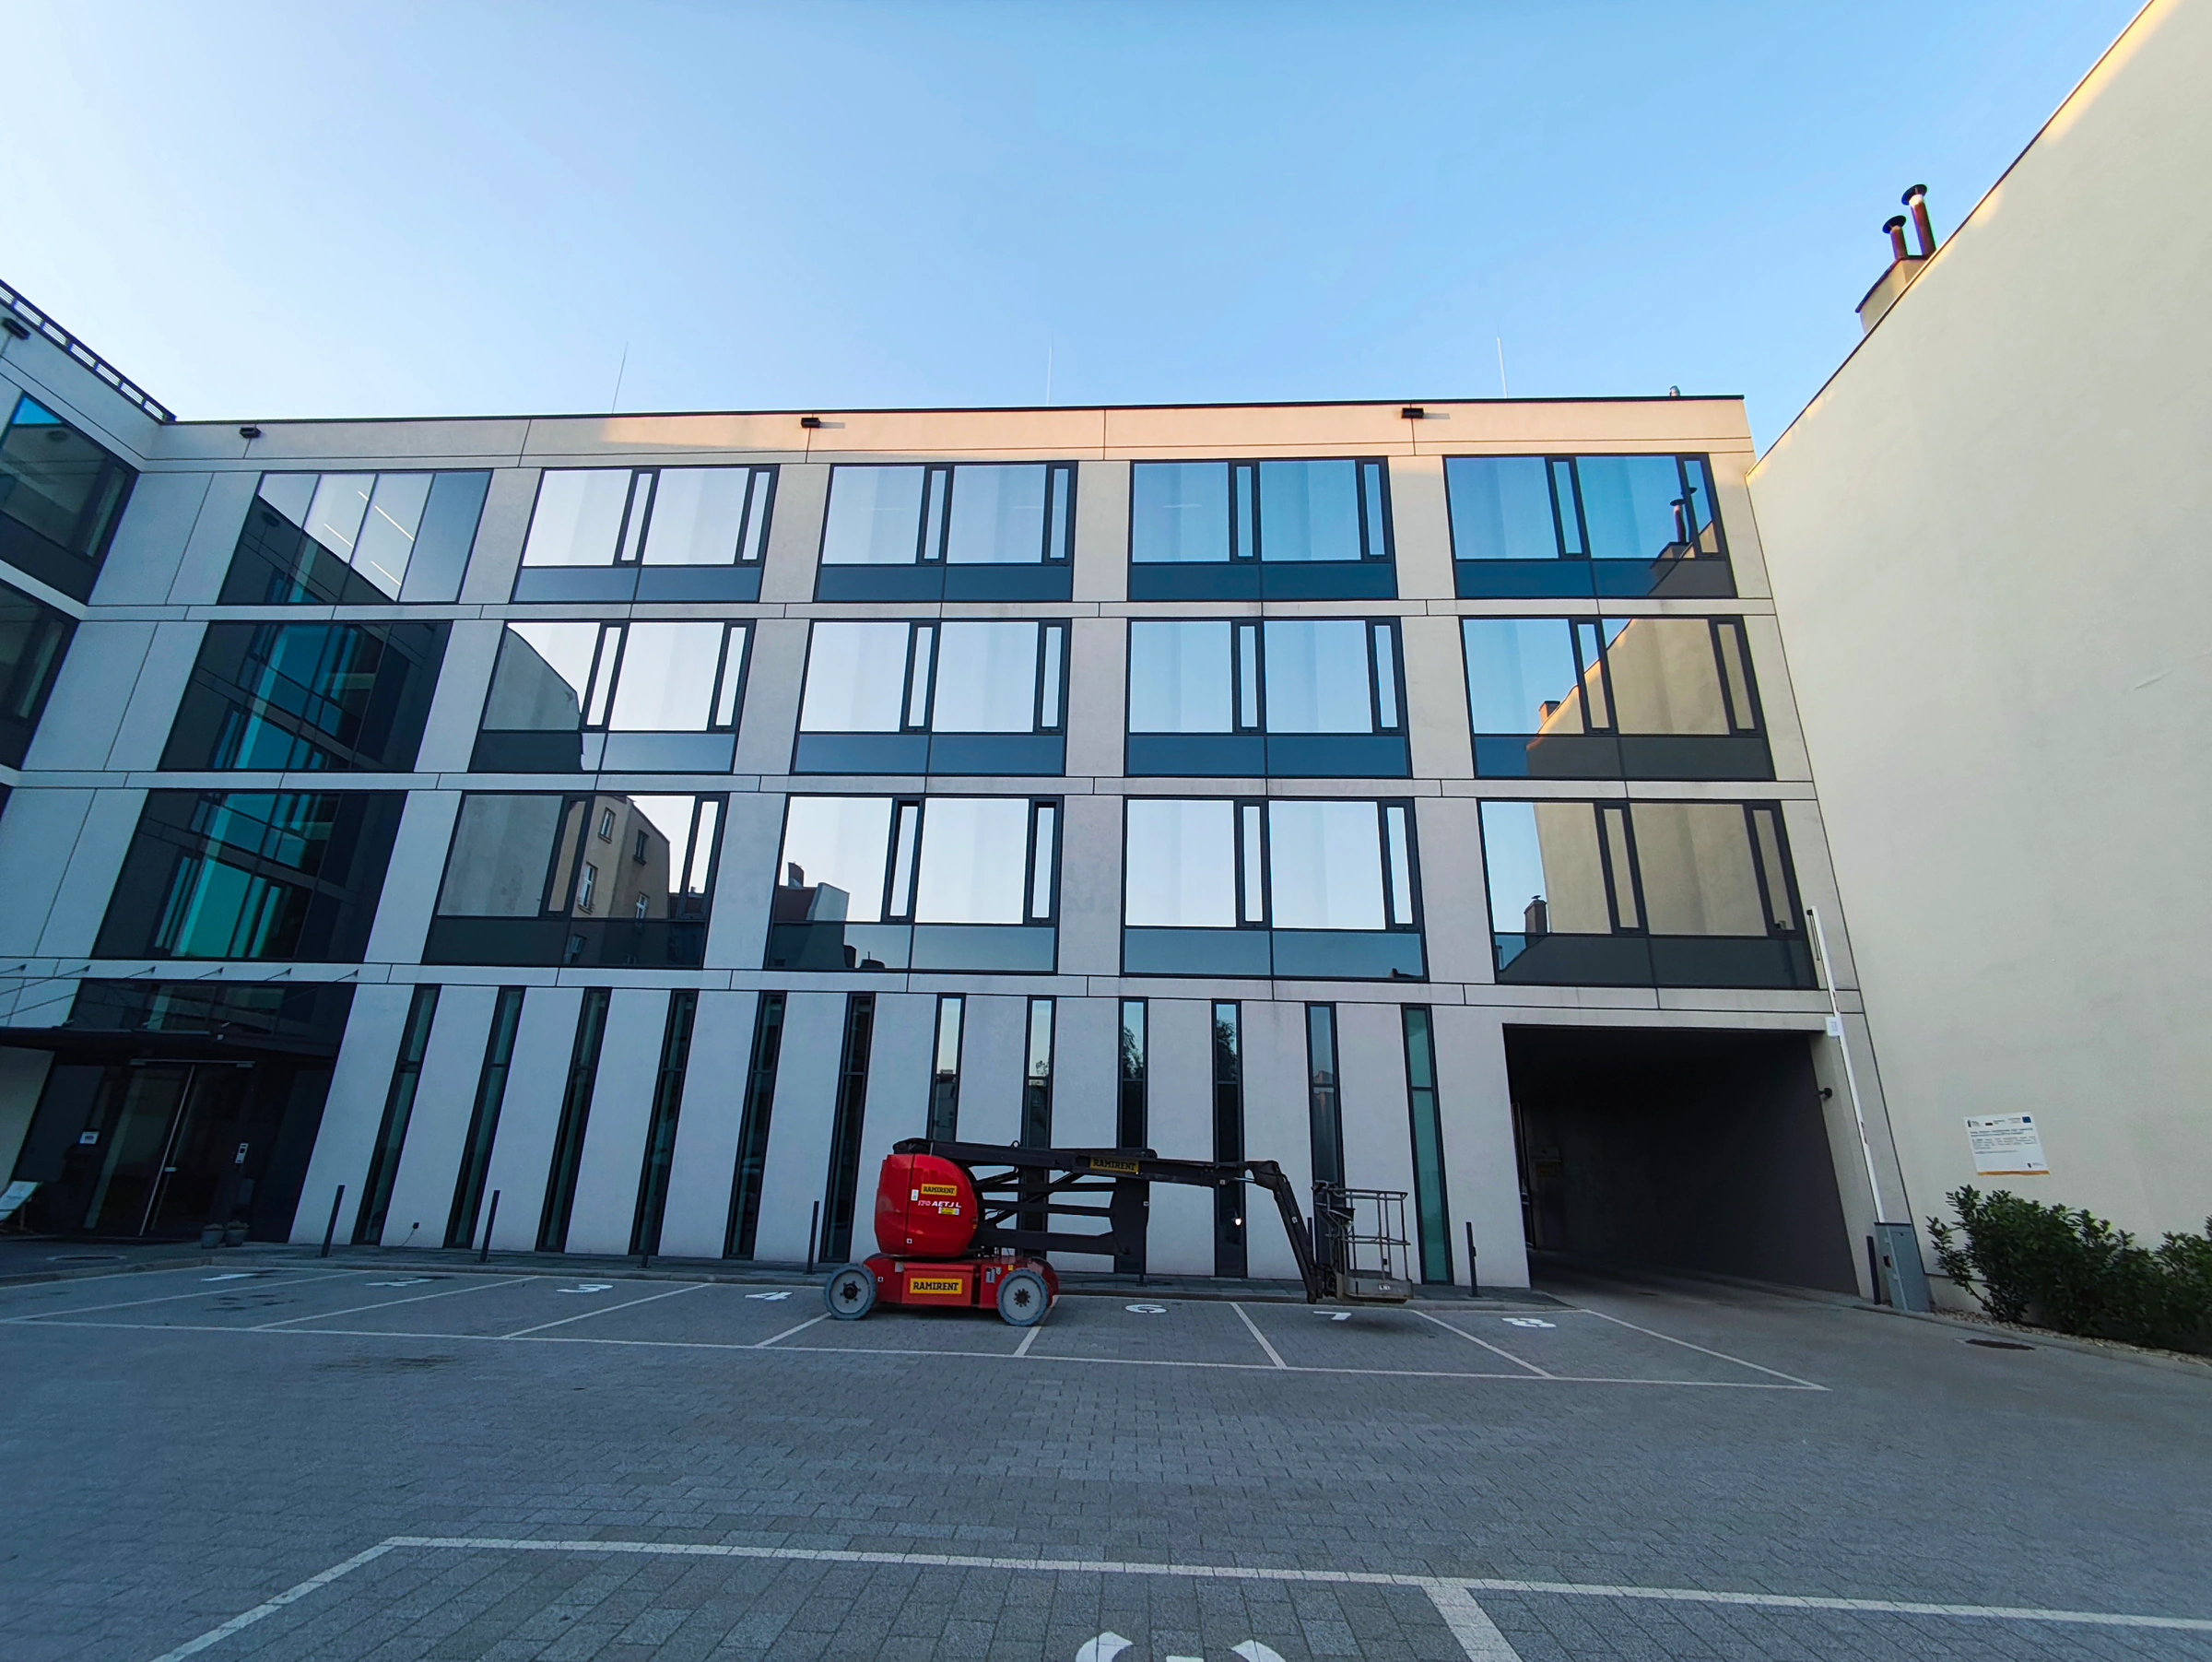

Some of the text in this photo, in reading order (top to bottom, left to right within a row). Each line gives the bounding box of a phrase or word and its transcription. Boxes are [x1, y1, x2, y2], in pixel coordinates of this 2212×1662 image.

[1093, 1159, 1136, 1171] RAMIRENT
[924, 1185, 955, 1194] RAMIRENT
[556, 1284, 614, 1293] 3
[912, 1281, 959, 1291] RAMIRENT
[745, 1291, 793, 1301] 4
[1125, 1303, 1167, 1314] 6
[1312, 1311, 1352, 1321] 7
[1501, 1317, 1557, 1327] 8
